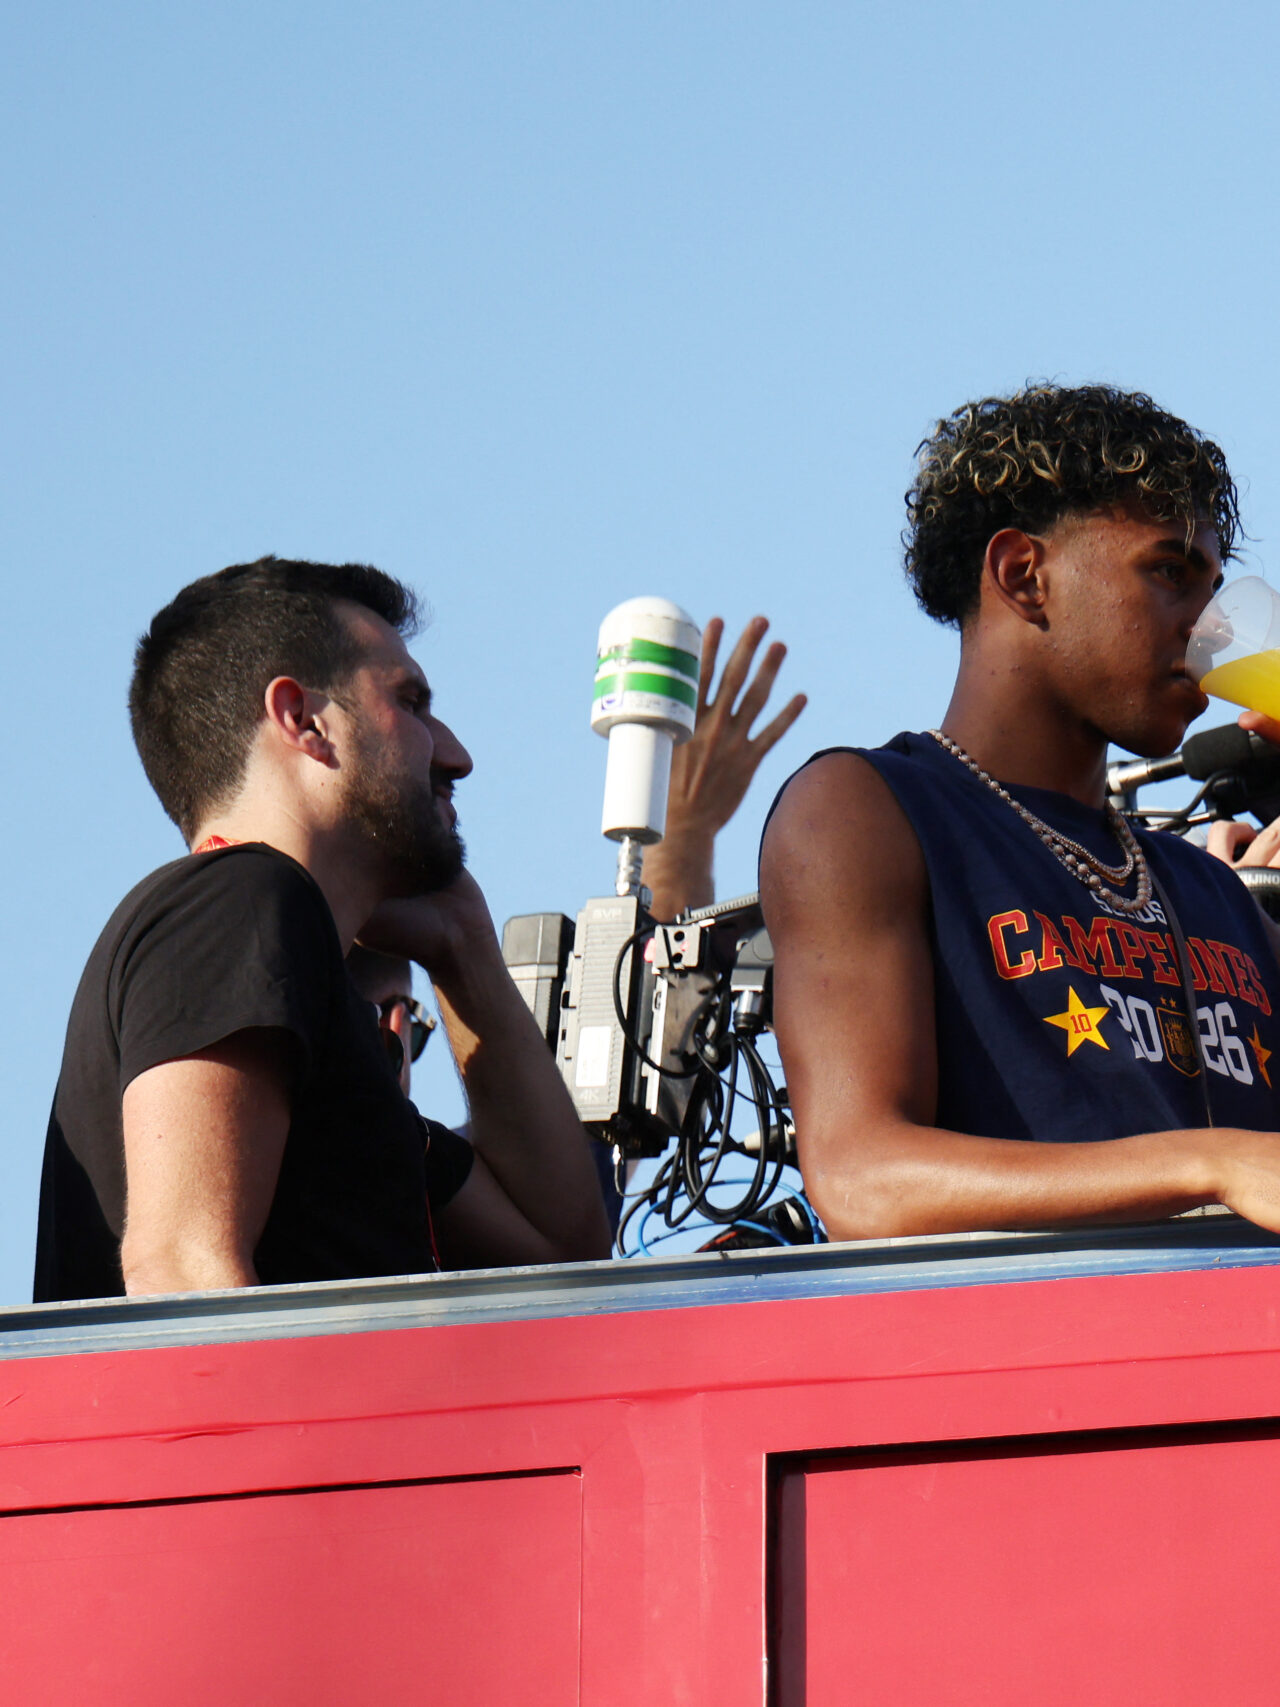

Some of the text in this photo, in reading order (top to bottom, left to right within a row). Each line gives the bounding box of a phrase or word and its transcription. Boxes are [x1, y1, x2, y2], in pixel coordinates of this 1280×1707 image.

[1089, 889, 1168, 926] SOS
[987, 908, 1273, 1017] CAMPEONES
[1070, 1013, 1093, 1034] 10
[1196, 1001, 1254, 1086] 26
